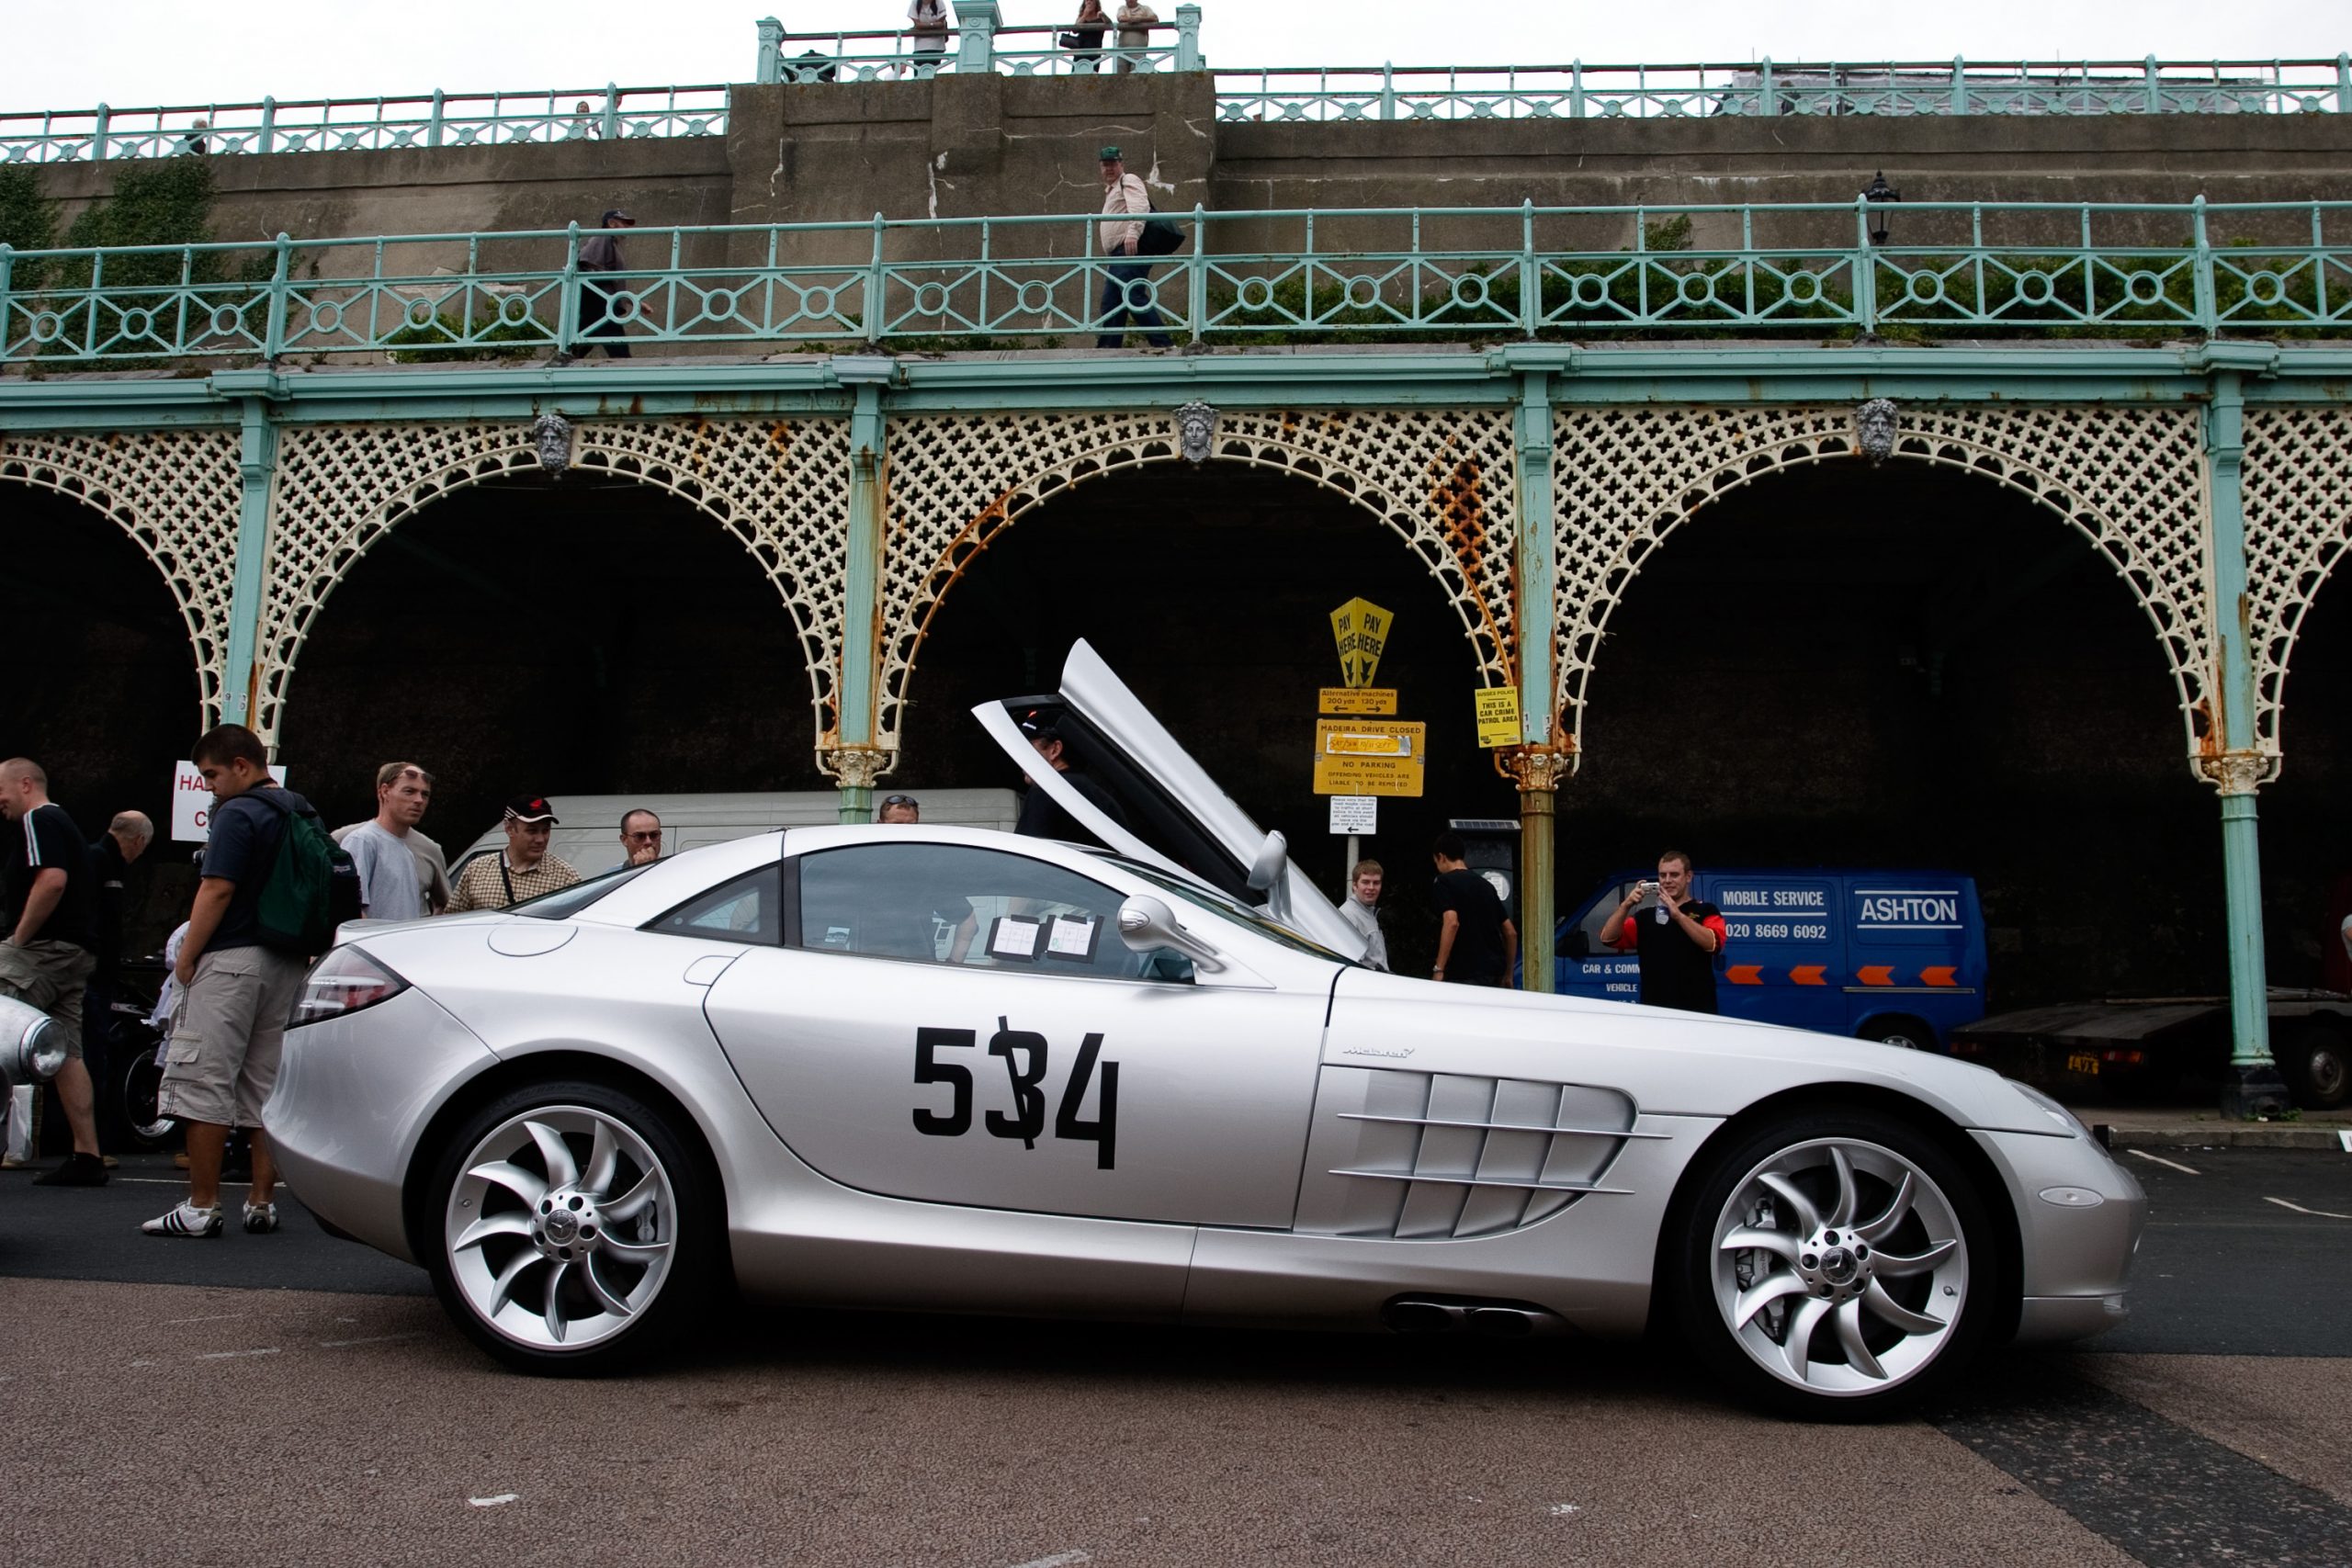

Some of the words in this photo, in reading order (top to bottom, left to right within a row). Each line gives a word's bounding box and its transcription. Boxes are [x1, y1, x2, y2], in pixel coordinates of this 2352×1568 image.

[1339, 613, 1351, 635] PAY
[1364, 613, 1382, 634] PAY
[1339, 633, 1356, 657] HERE
[1357, 633, 1382, 657] HERE
[1723, 891, 1769, 906] MOBILE
[1773, 891, 1824, 906] SERVICE
[1860, 898, 1957, 921] ASHTON
[1725, 924, 1750, 937] 020
[1755, 924, 1788, 938] 8669
[1793, 925, 1826, 939] 6092
[1583, 964, 1601, 974] CAR
[1604, 964, 1612, 974] &
[1606, 983, 1638, 992] VEHICLE
[912, 1016, 1119, 1170] 534
